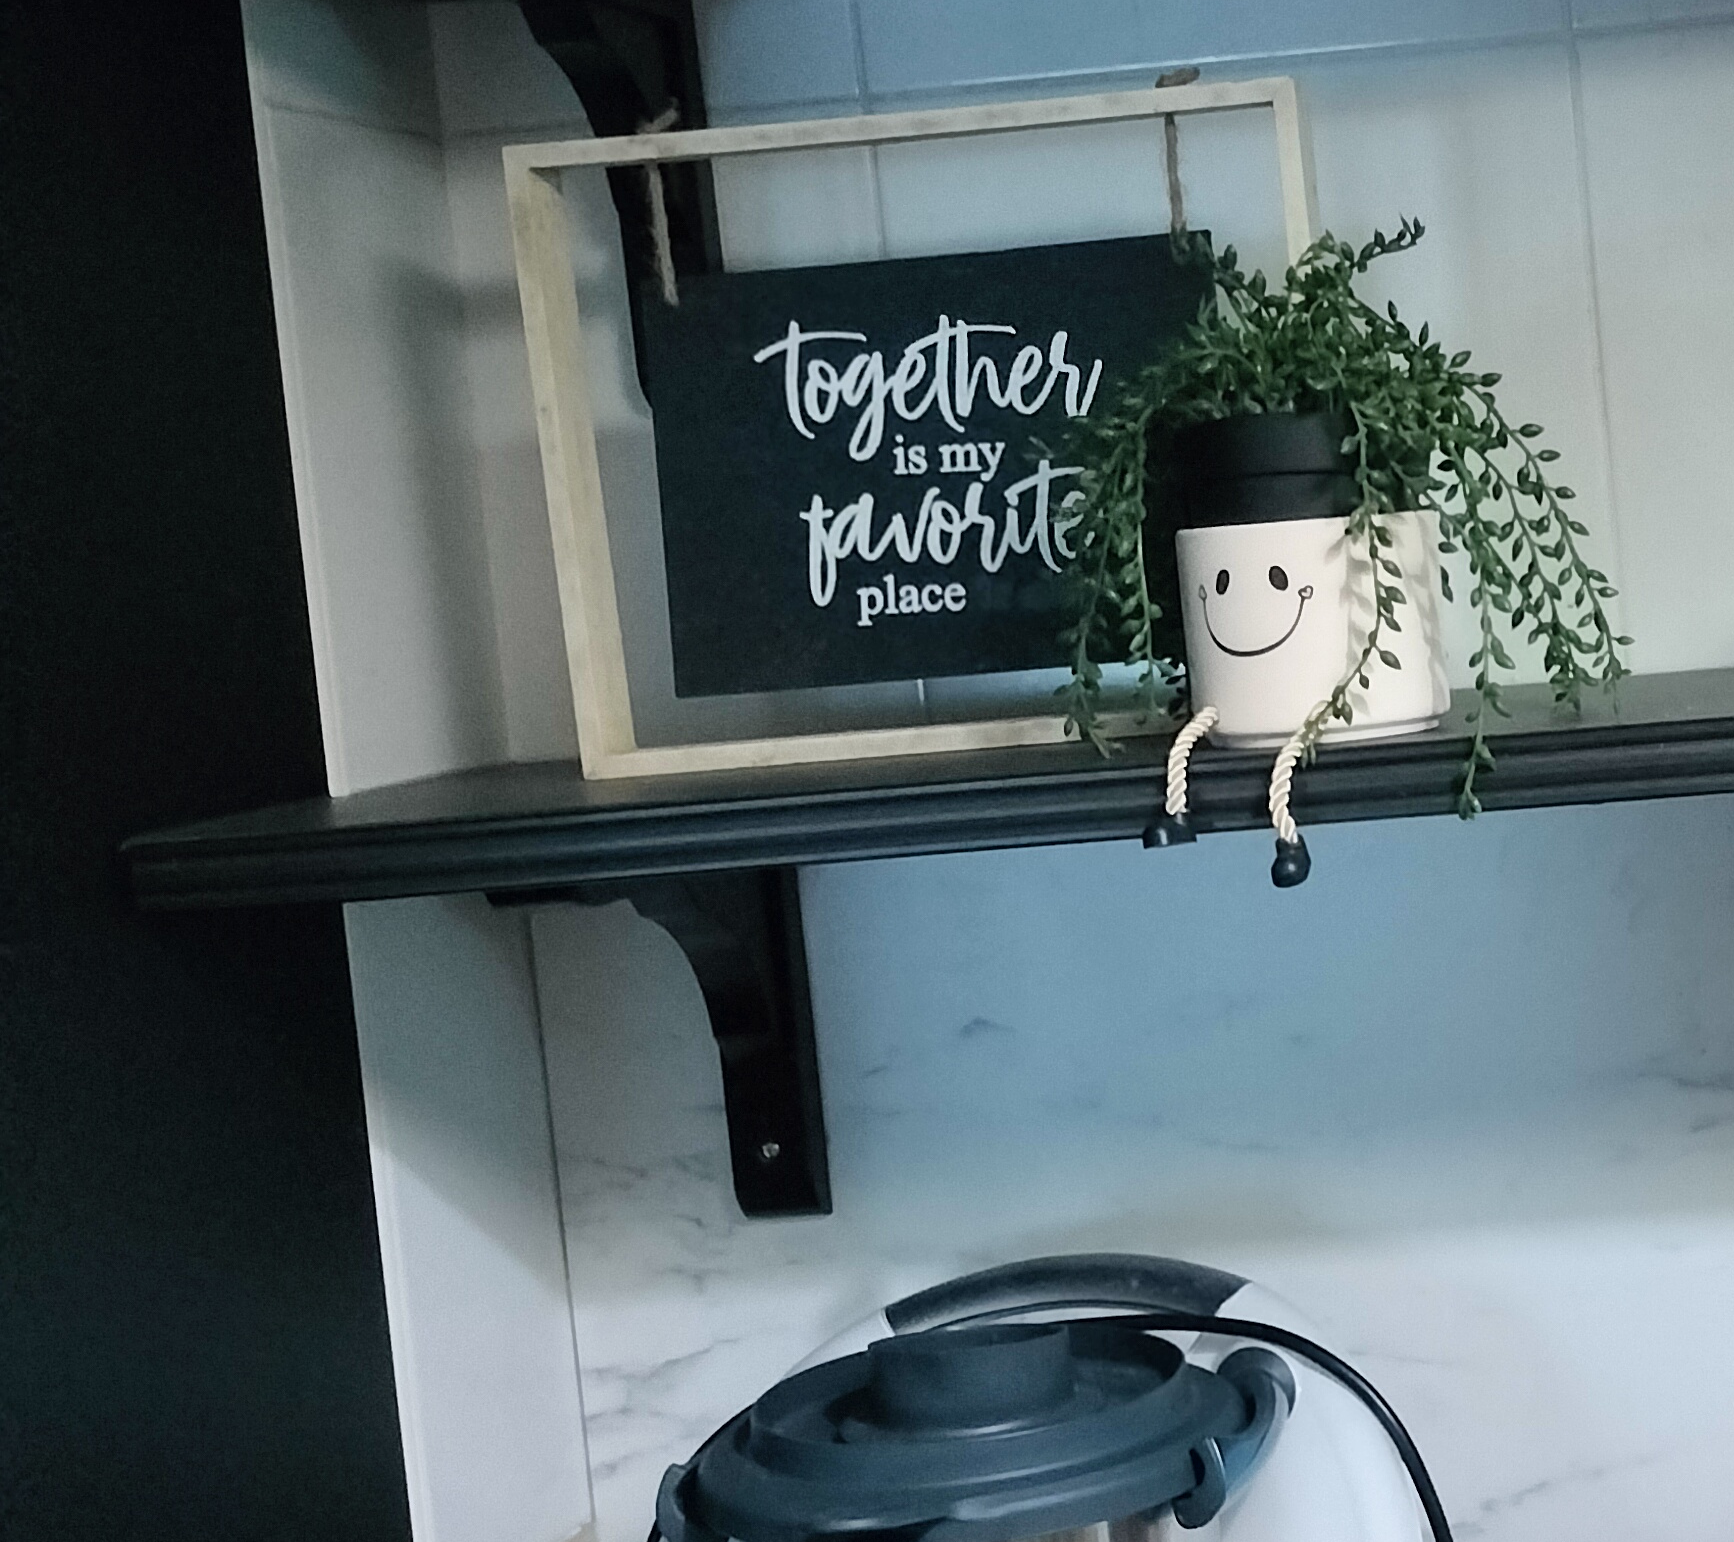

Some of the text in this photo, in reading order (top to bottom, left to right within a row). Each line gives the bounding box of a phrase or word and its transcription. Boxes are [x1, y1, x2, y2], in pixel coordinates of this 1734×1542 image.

[754, 314, 1103, 461] together
[893, 435, 1005, 482] is my
[799, 459, 1096, 607] favorite
[856, 574, 967, 626] place
